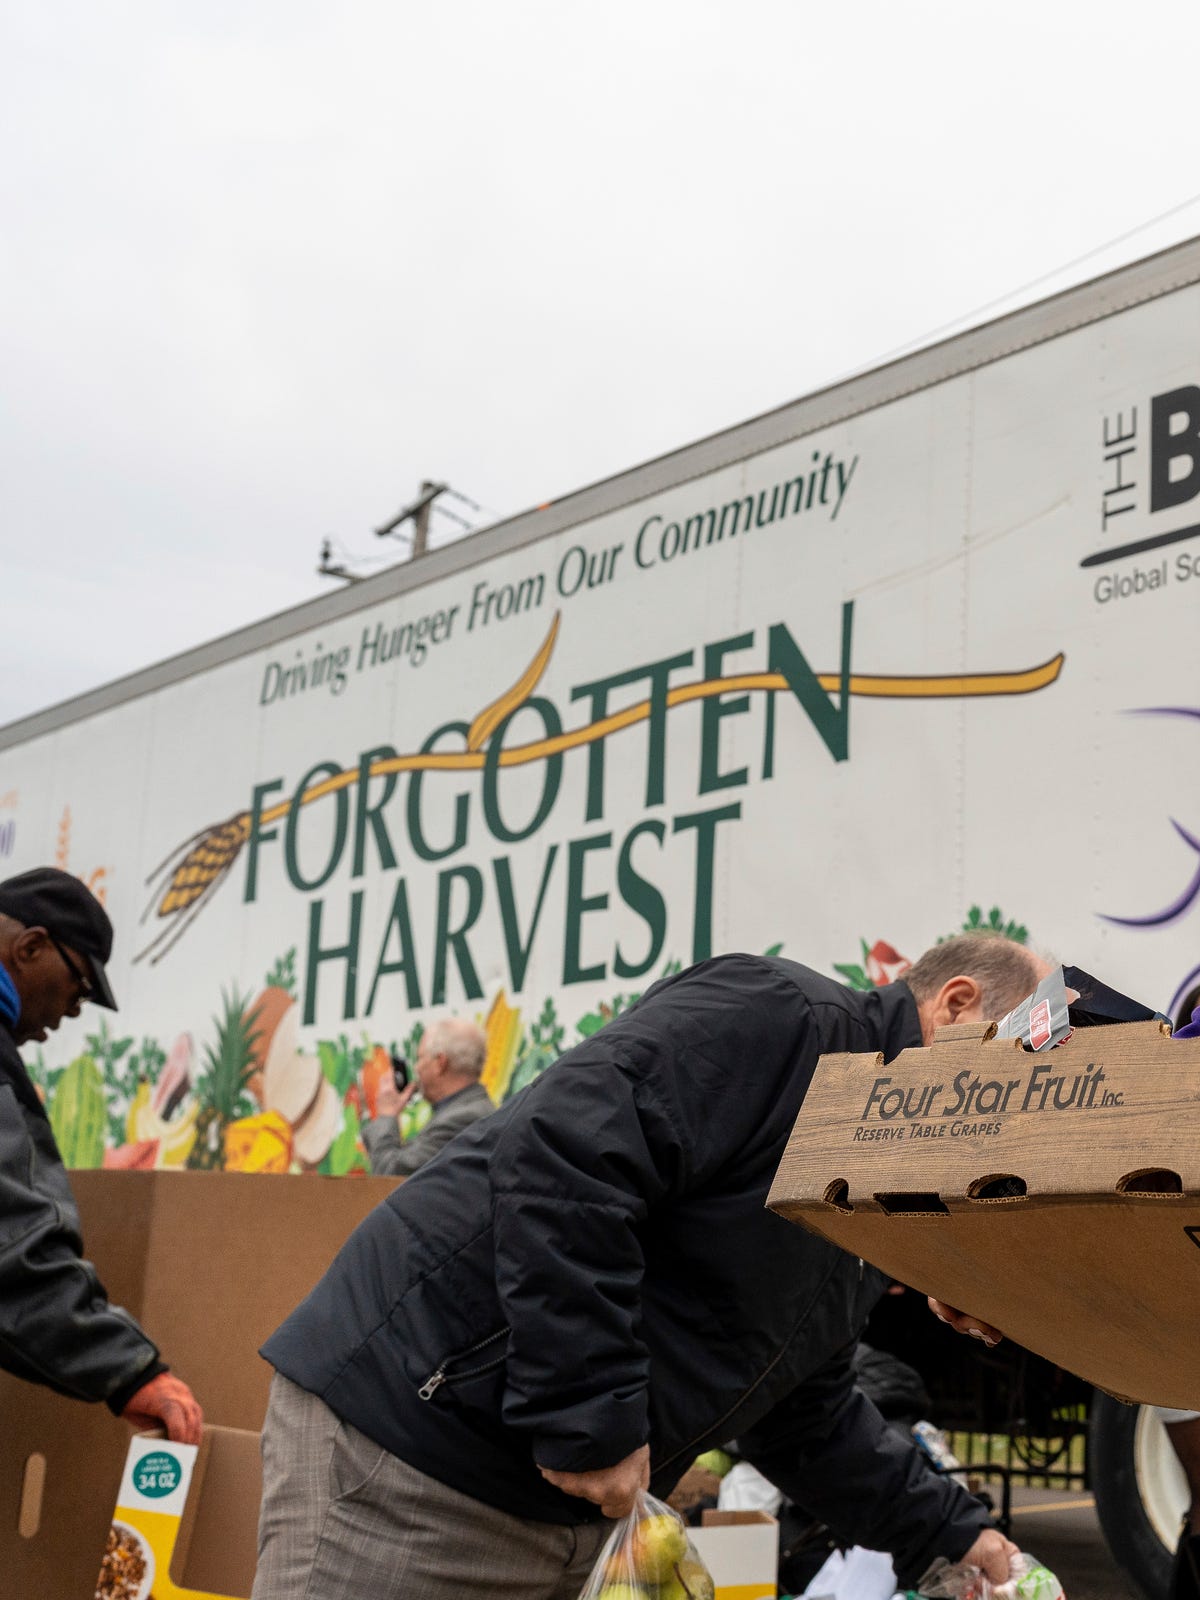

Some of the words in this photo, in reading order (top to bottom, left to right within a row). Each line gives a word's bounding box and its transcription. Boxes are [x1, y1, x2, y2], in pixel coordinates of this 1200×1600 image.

[1103, 405, 1138, 532] THE
[260, 643, 350, 706] Driving
[357, 606, 460, 672] Hunger
[467, 571, 546, 632] From
[556, 544, 624, 597] Our
[635, 450, 859, 569] Community
[1094, 561, 1168, 604] Global
[244, 600, 854, 902] FORGOTTEN
[302, 801, 742, 1028] HARVEST
[861, 1077, 943, 1121] Four
[942, 1070, 1021, 1117] Star
[1101, 1088, 1124, 1107] Inc.
[138, 1474, 156, 1490] 34
[158, 1472, 176, 1488] OZ
